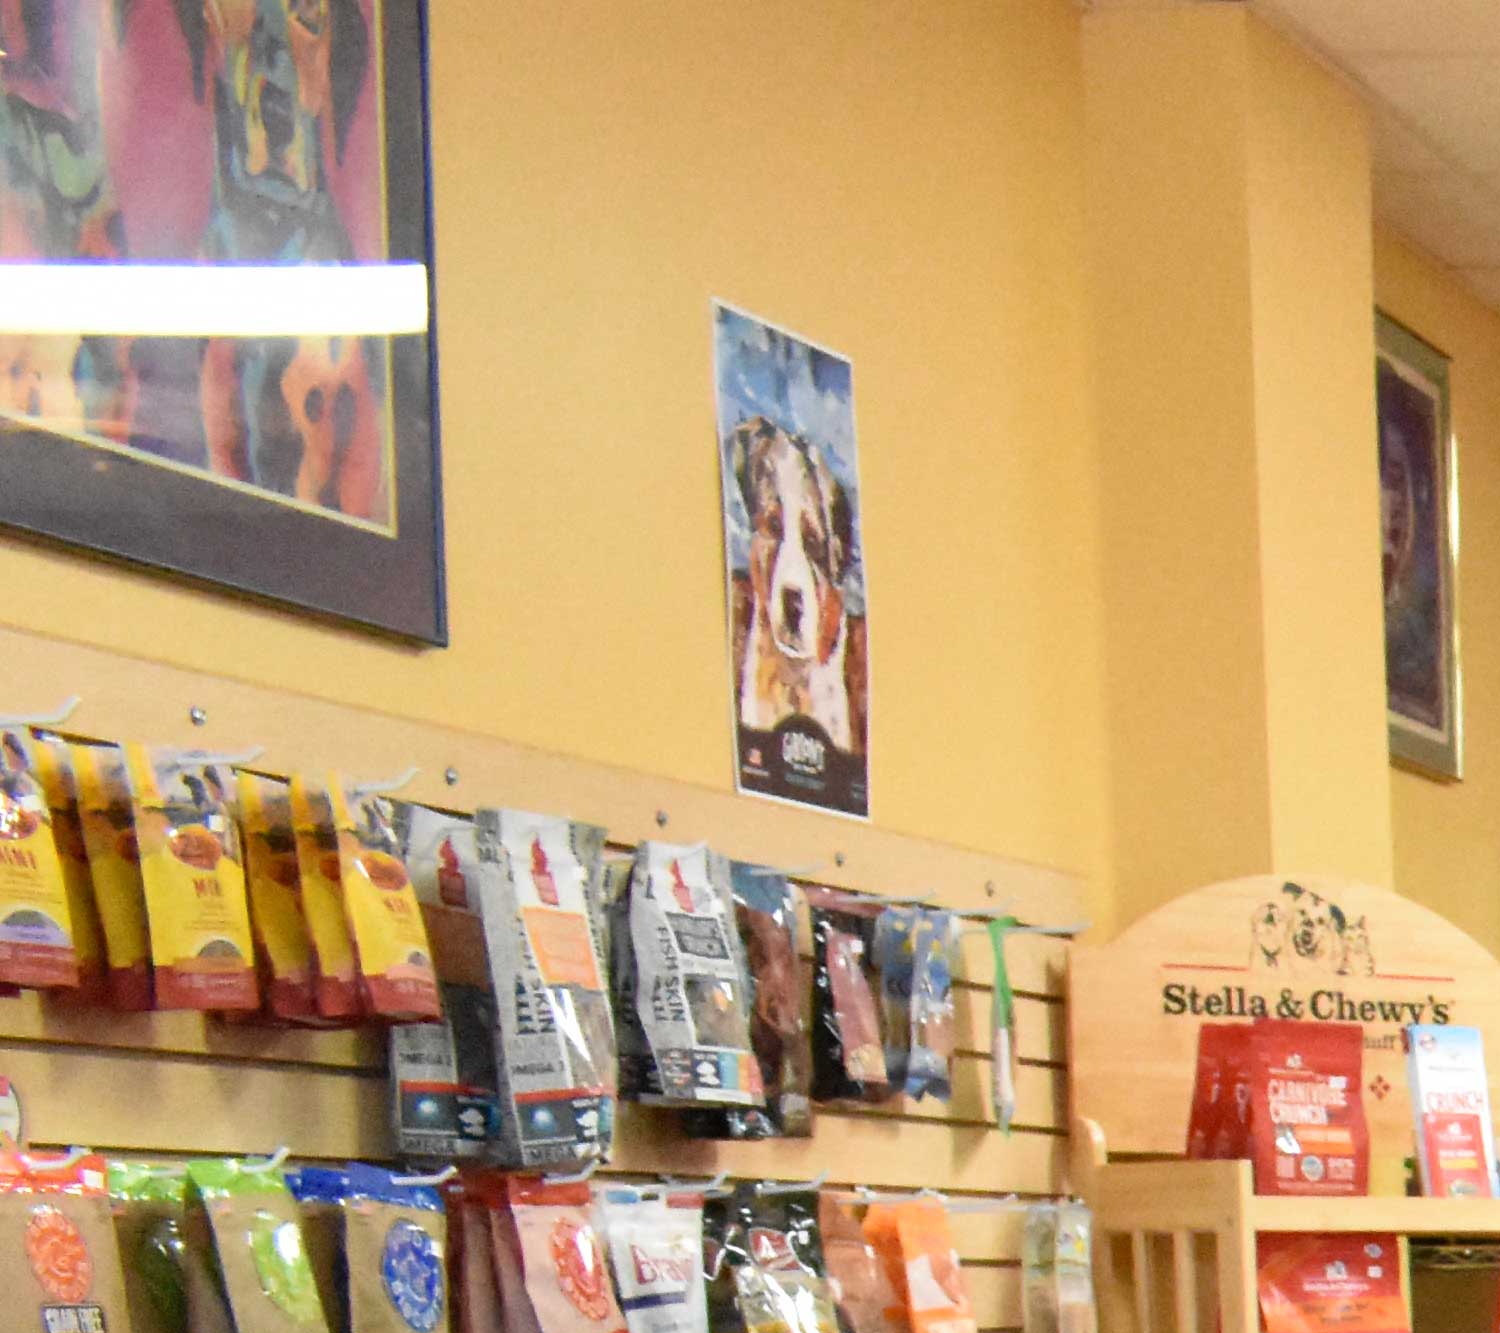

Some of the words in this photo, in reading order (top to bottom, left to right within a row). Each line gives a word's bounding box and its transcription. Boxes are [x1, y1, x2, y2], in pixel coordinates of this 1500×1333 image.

[1162, 982, 1267, 1019] Stella
[1276, 988, 1303, 1016] &
[1310, 990, 1452, 1024] Chewy's
